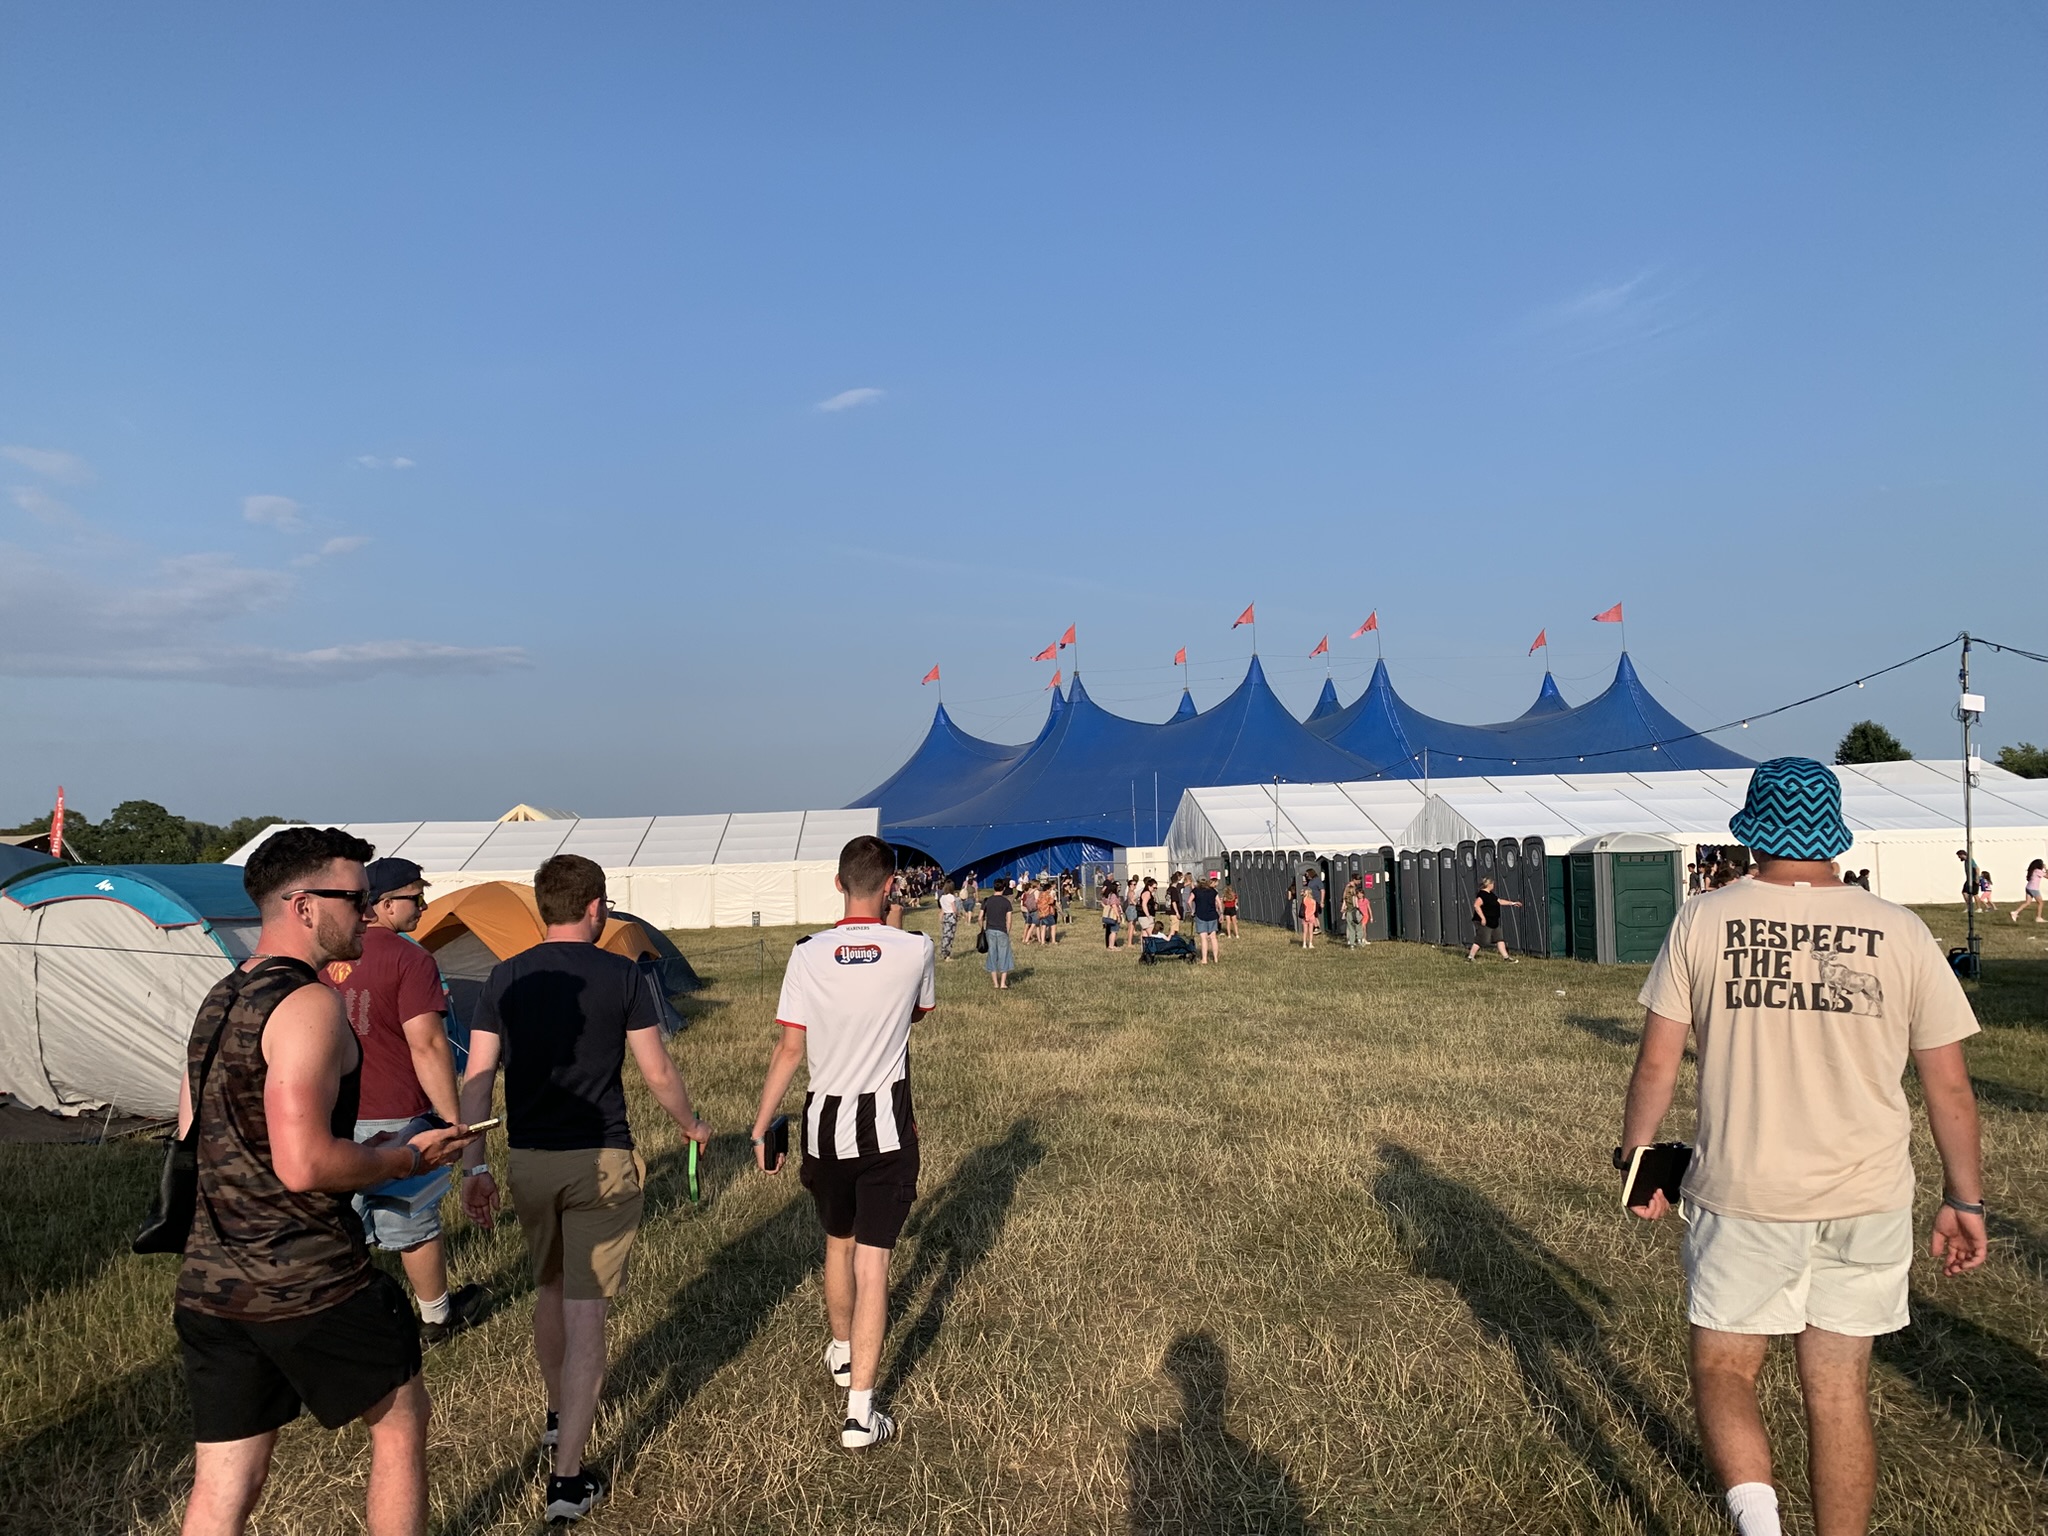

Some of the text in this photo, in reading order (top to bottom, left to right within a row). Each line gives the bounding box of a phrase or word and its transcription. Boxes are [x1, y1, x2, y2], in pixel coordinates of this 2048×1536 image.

[1725, 919, 1884, 957] RESPECT
[840, 946, 878, 963] Young's
[1723, 948, 1792, 979] THE
[1725, 979, 1853, 1013] LOCALS
